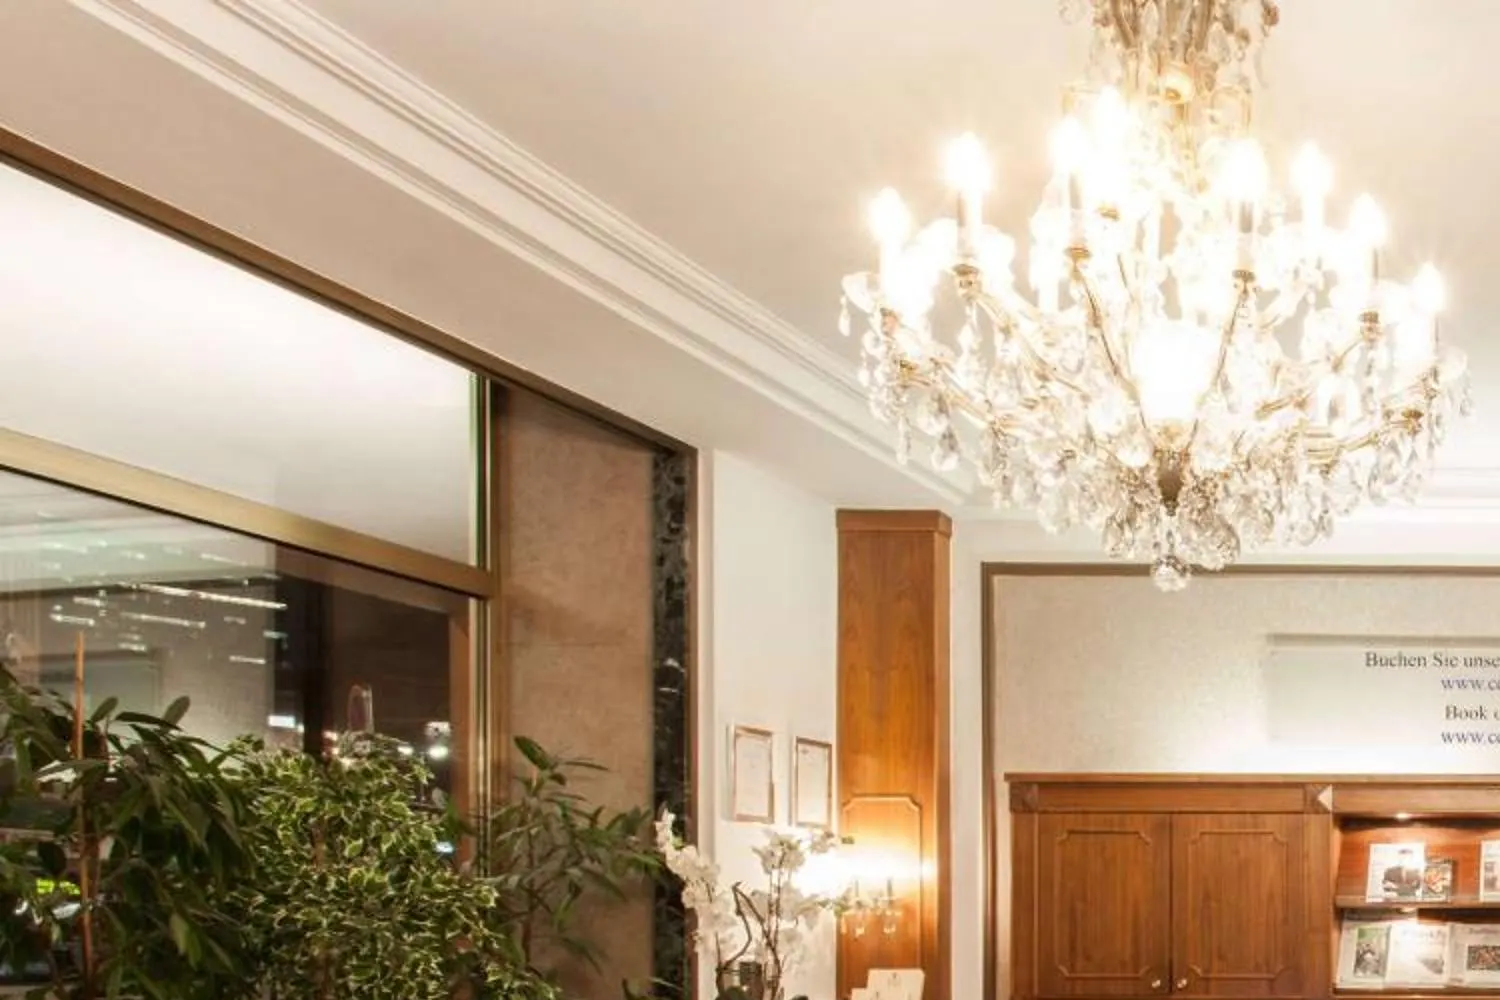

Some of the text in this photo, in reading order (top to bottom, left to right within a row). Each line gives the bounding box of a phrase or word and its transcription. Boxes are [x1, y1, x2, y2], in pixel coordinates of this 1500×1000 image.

[1365, 651, 1427, 668] Buchen
[1432, 651, 1459, 668] Sie
[1444, 704, 1488, 721] Book
